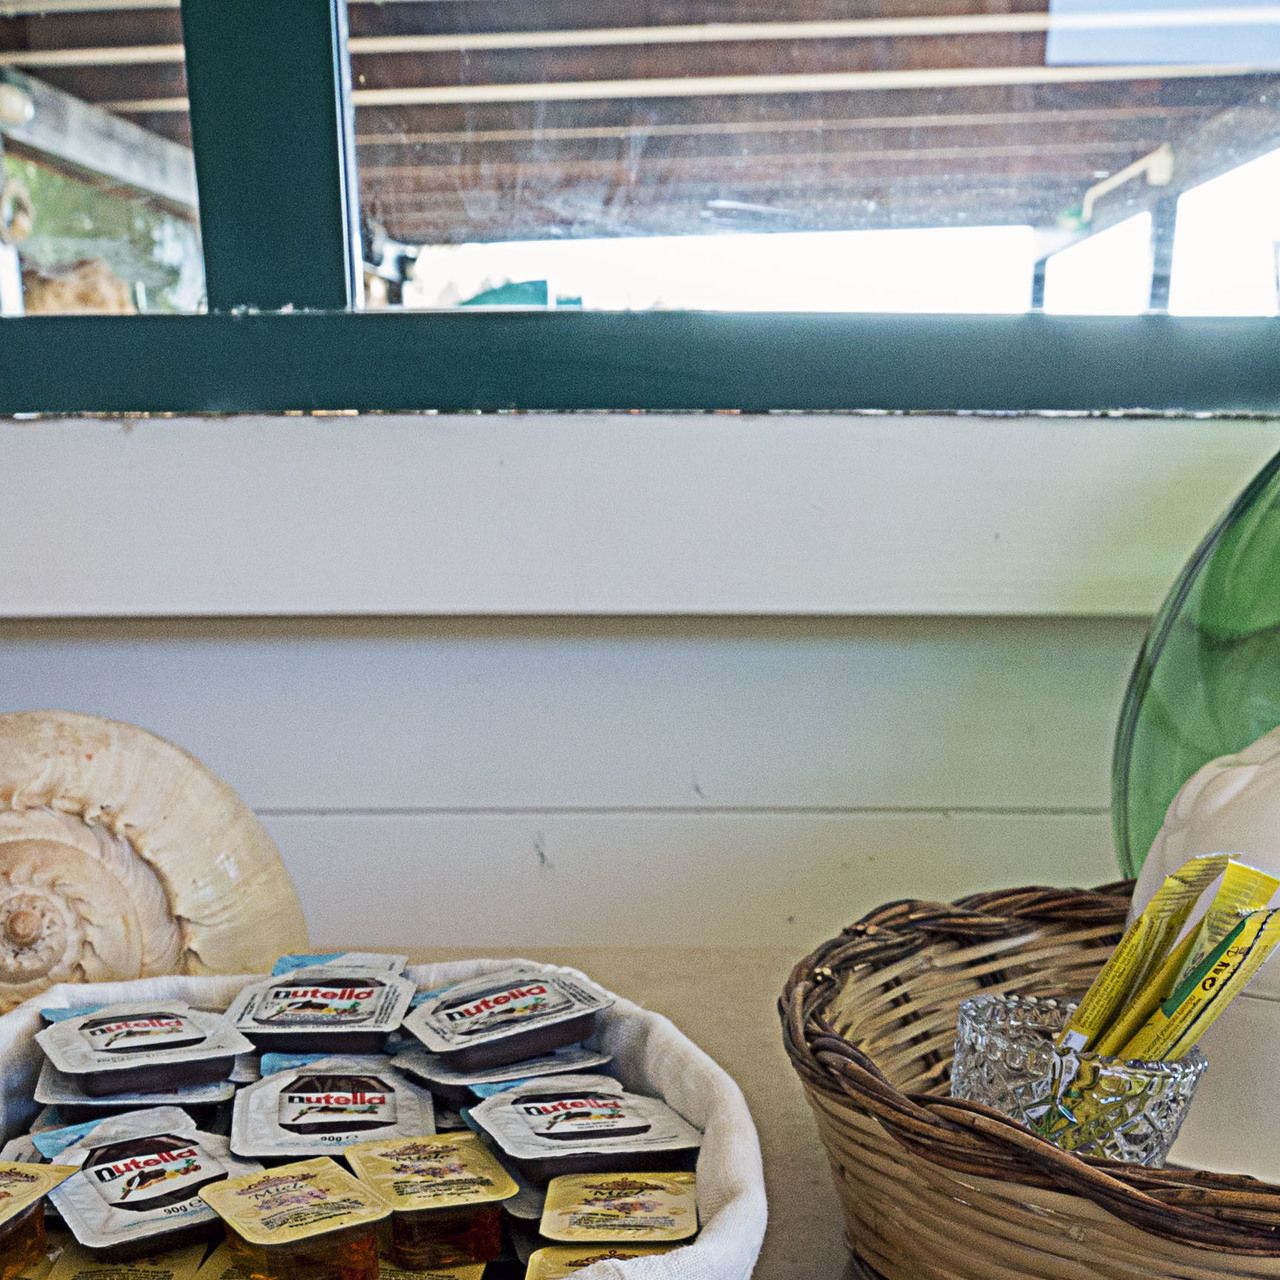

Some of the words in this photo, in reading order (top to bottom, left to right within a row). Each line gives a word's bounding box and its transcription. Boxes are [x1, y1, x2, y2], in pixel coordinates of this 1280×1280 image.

[272, 988, 375, 1000] nutella
[445, 985, 548, 1022] nutella
[90, 1018, 184, 1036] nutella
[288, 1093, 386, 1105] nutella
[524, 1099, 621, 1116] nutella
[94, 1148, 198, 1183] nutella
[164, 1205, 188, 1215] 90g
